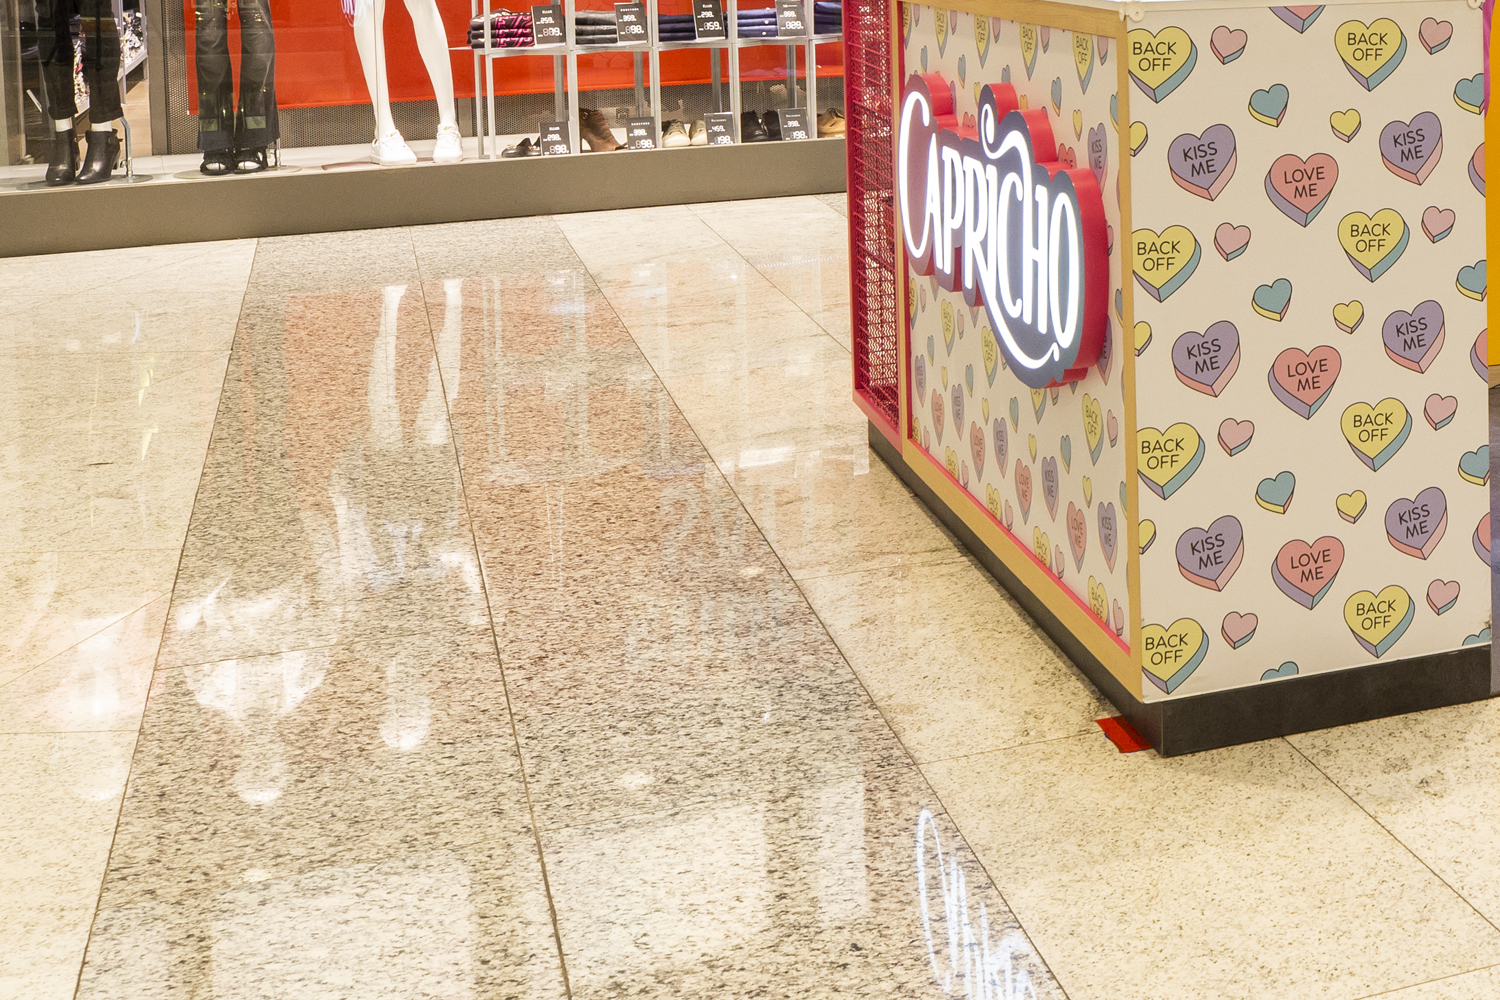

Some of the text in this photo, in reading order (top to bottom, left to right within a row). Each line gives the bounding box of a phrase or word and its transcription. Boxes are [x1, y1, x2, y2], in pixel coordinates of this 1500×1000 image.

[1346, 32, 1388, 47] BACK
[1132, 41, 1177, 56] BACK
[1352, 48, 1384, 62] OFF
[1138, 58, 1172, 72] OFF
[1392, 128, 1426, 147] KISS
[1182, 141, 1219, 162] KISS
[1399, 147, 1425, 162] ME
[1190, 162, 1217, 178] ME
[1283, 166, 1326, 184] LOVE
[1293, 184, 1319, 199] ME
[899, 90, 1081, 370] CAPRICHO
[1349, 223, 1391, 237] BACK
[1136, 240, 1181, 256] BACK
[1355, 239, 1387, 253] OFF
[1142, 257, 1176, 272] OFF
[1394, 317, 1429, 336] KISS
[1186, 338, 1222, 359] KISS
[1402, 335, 1427, 352] ME
[1194, 356, 1221, 375] ME
[1286, 358, 1329, 377] LOVE
[1296, 376, 1322, 392] ME
[1352, 412, 1394, 427] BACK
[1358, 428, 1389, 443] OFF
[1140, 437, 1186, 454] BACK
[1146, 455, 1180, 470] OFF
[1397, 504, 1431, 524] KISS
[1405, 521, 1430, 539] ME
[1190, 533, 1226, 553] KISS
[1198, 553, 1225, 570] ME
[1290, 548, 1332, 568] LOVE
[1300, 567, 1325, 583] ME
[1355, 599, 1397, 616] BACK
[1360, 616, 1392, 630] OFF
[1144, 632, 1189, 649] BACK
[1150, 650, 1184, 666] OFF
